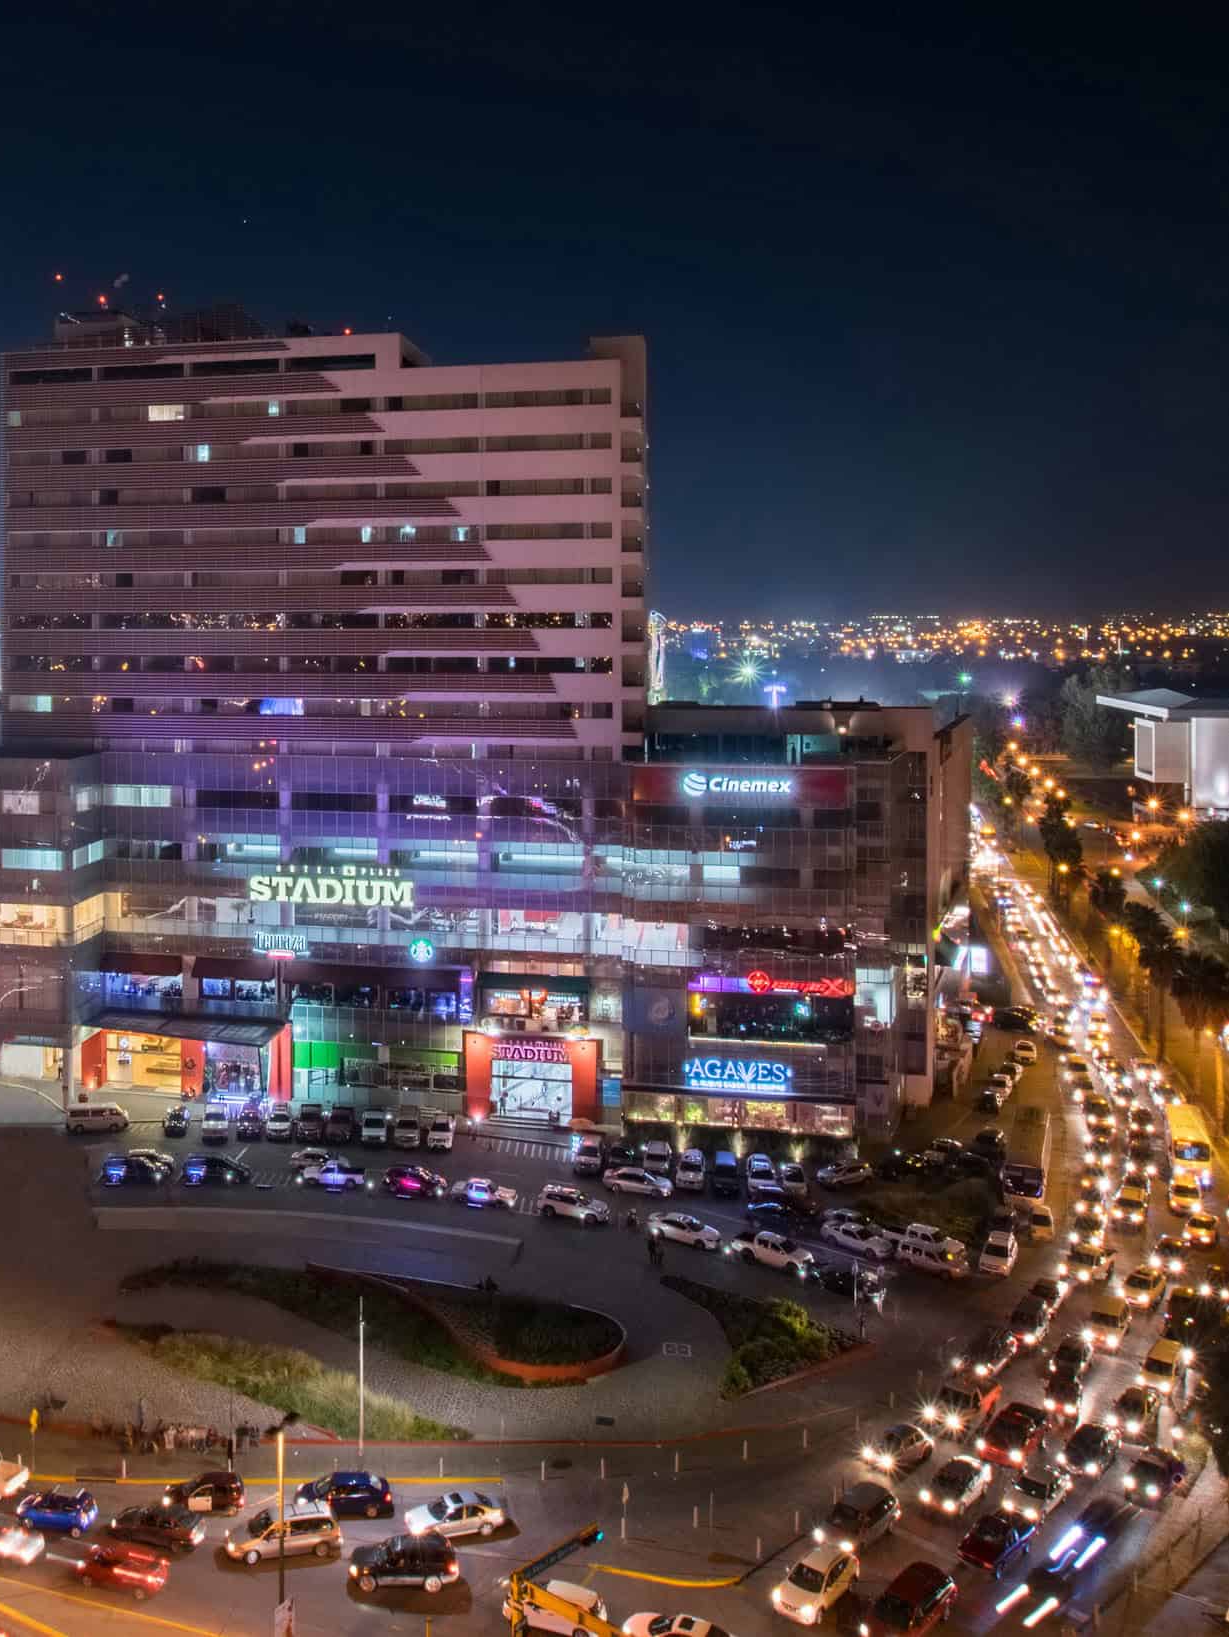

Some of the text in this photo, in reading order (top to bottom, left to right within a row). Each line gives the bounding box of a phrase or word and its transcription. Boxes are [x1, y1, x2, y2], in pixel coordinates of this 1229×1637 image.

[709, 777, 791, 793] Cinemex
[276, 864, 400, 877] HOTEL PLAZA
[249, 875, 414, 907] STADIUM
[491, 1044, 571, 1062] STADIUM
[688, 1058, 785, 1081] AGAVES
